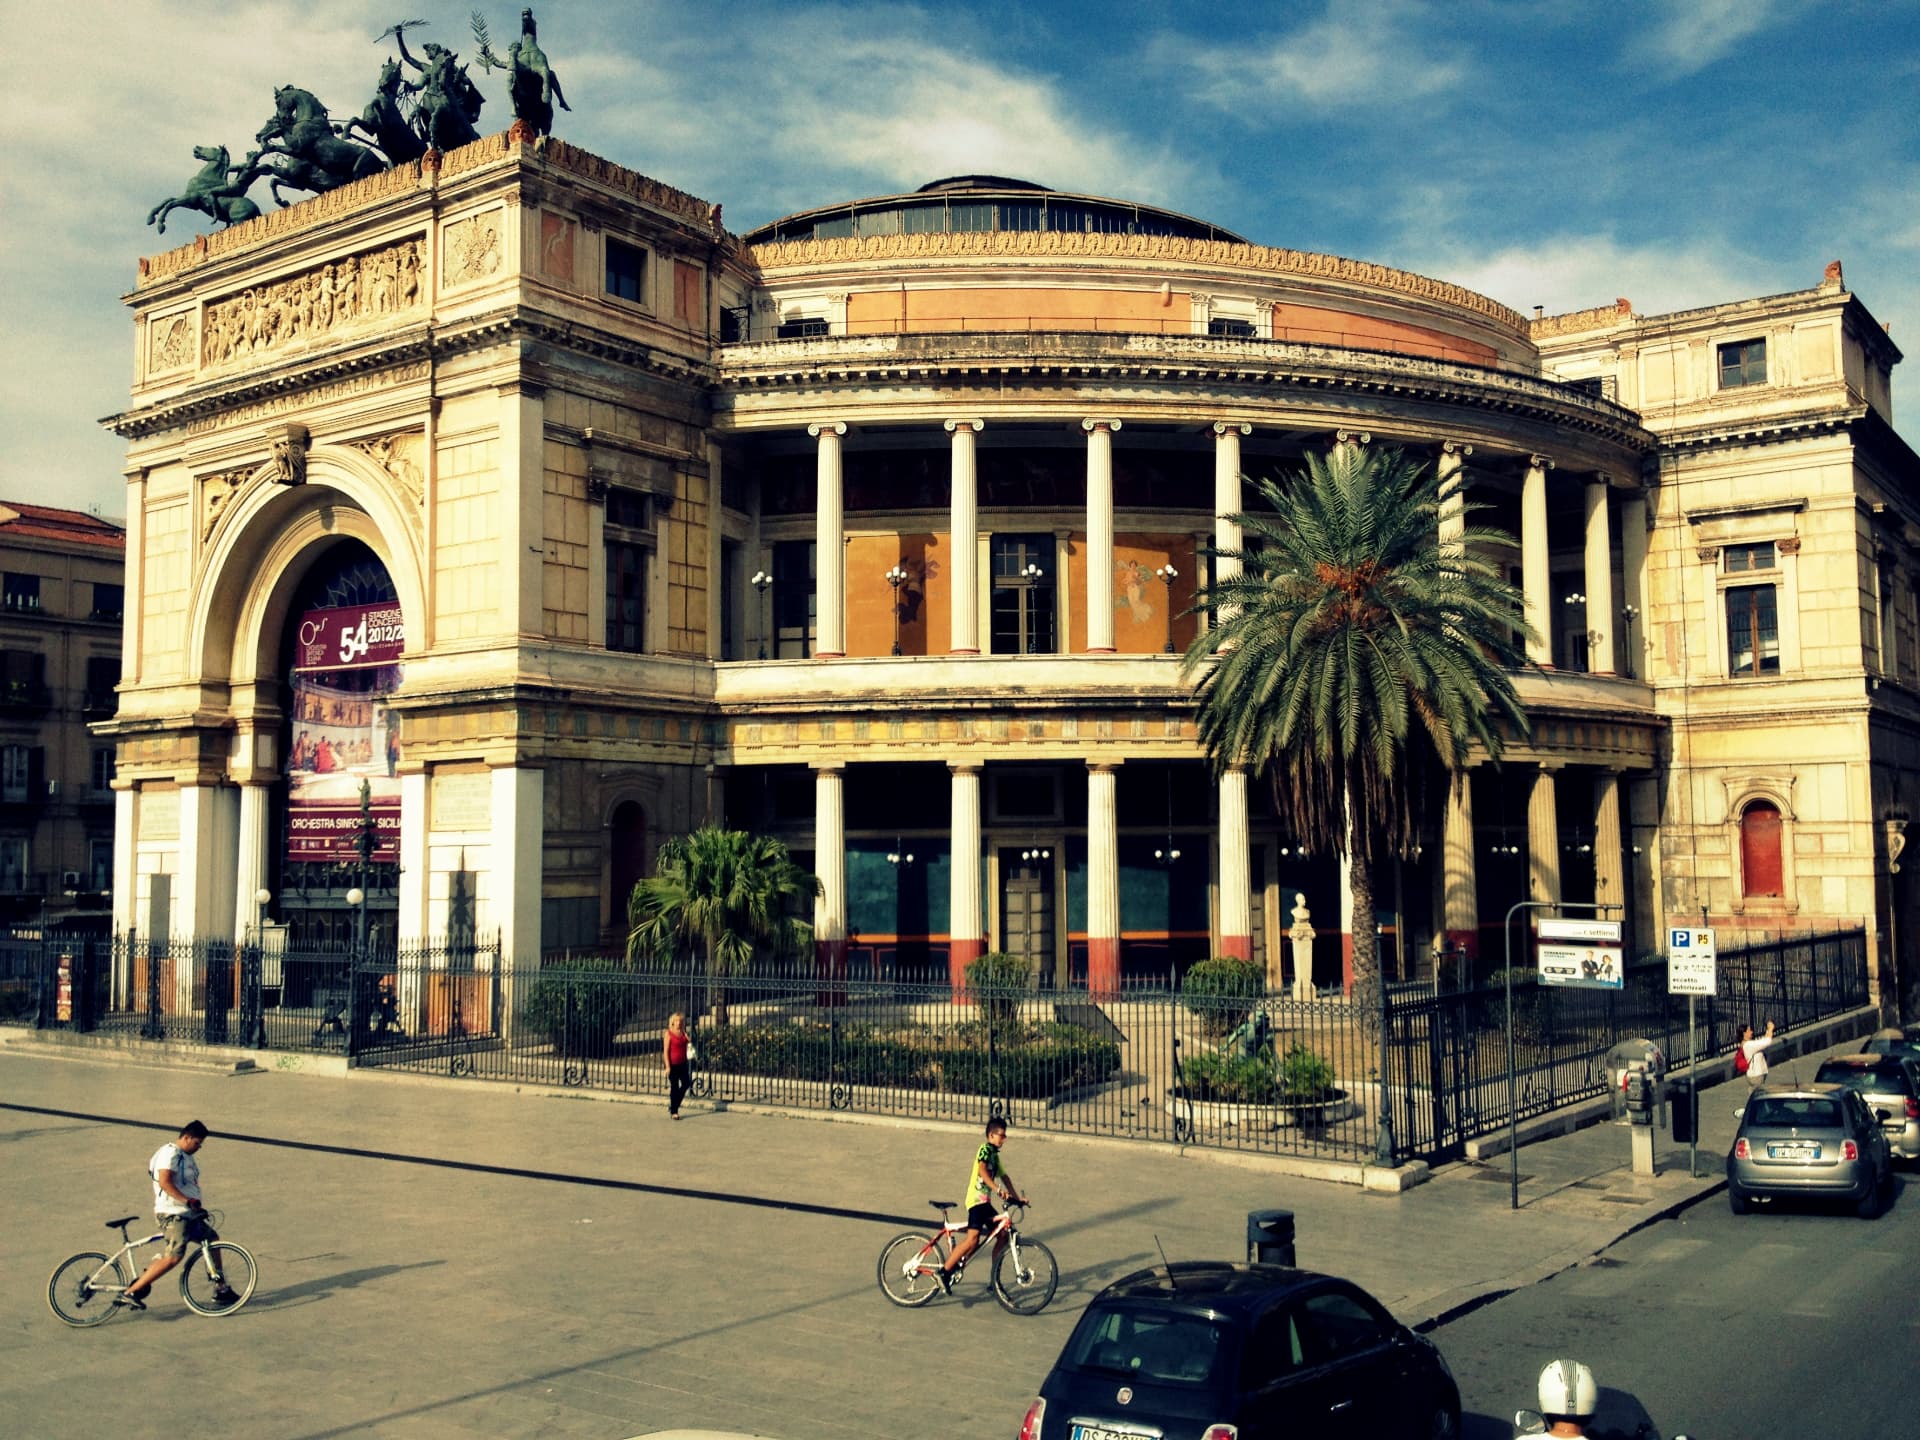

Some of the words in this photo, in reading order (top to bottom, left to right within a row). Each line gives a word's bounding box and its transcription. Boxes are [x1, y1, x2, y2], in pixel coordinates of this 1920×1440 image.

[368, 608, 402, 619] STAGIONE
[291, 818, 335, 829] ORCHESTRA
[1675, 931, 1688, 947] P
[1697, 933, 1708, 945] P5
